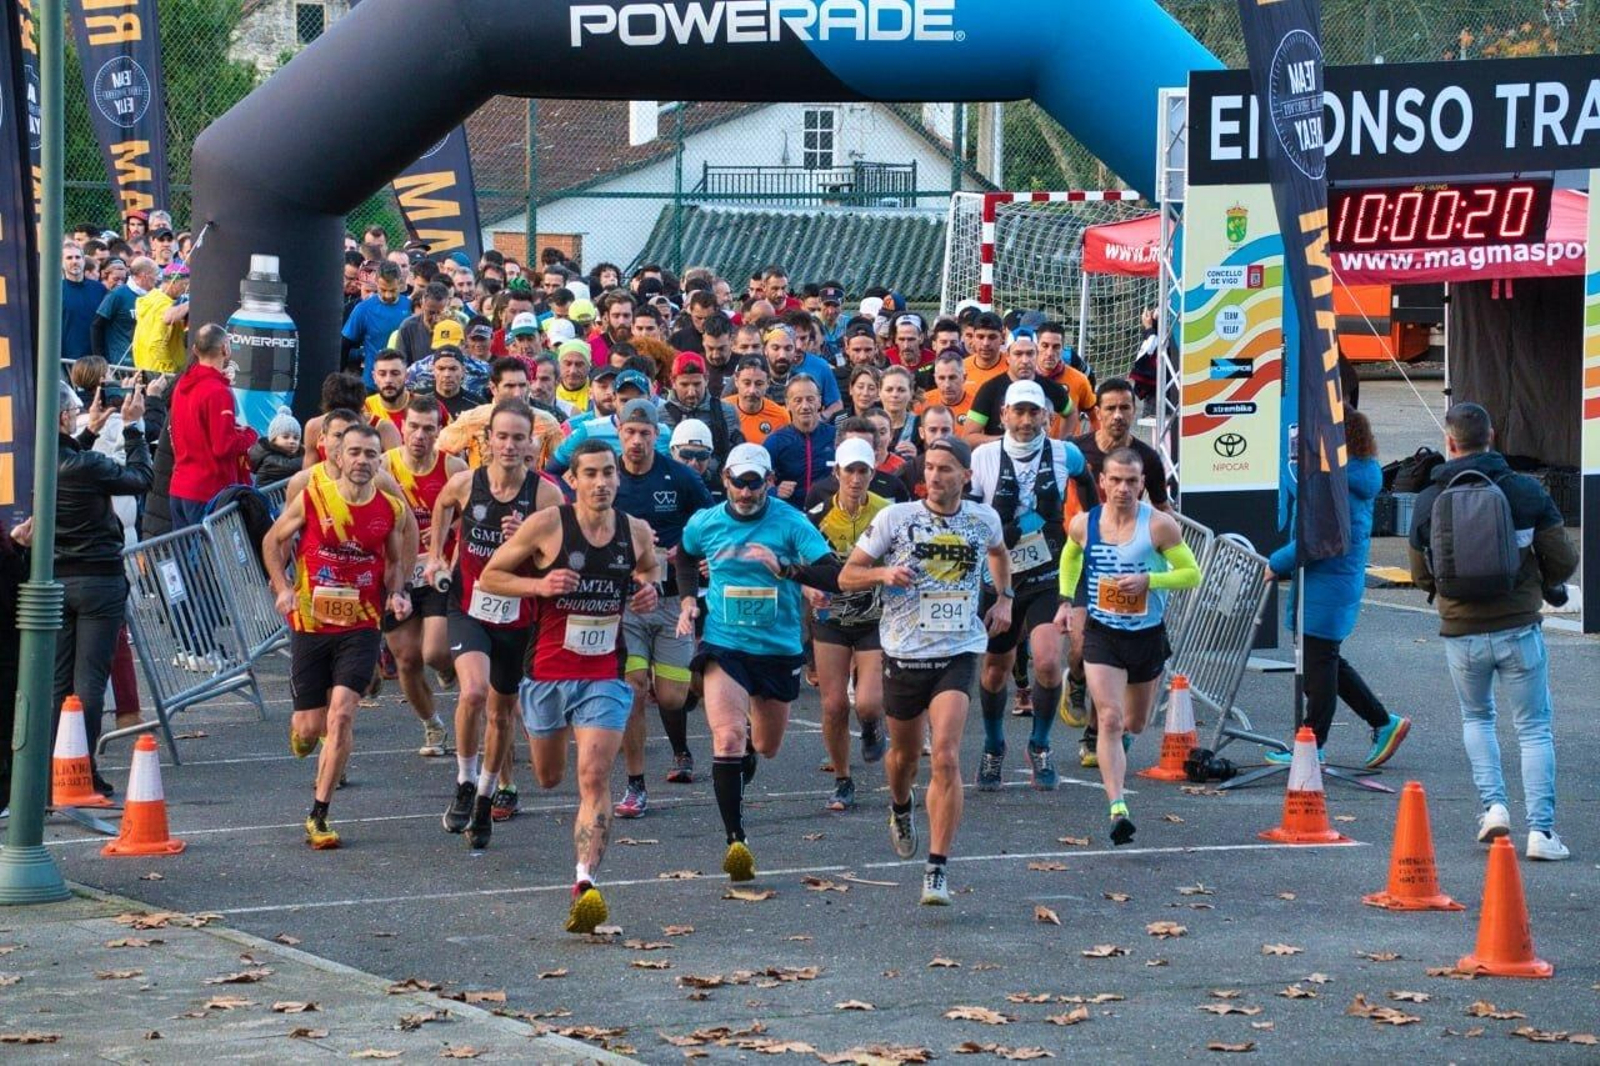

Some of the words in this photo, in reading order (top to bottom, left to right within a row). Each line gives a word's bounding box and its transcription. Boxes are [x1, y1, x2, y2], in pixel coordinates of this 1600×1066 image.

[1335, 187, 1534, 243] 10:00:20
[1339, 241, 1587, 270] www.magmaspo
[1212, 463, 1250, 472] NIPOCAR
[1009, 545, 1039, 564] 278
[323, 600, 355, 617] 183
[480, 596, 511, 615] 276
[556, 597, 621, 611] CHUVONERS
[735, 600, 765, 616] 122
[930, 602, 963, 619] 294
[579, 629, 607, 646] 101
